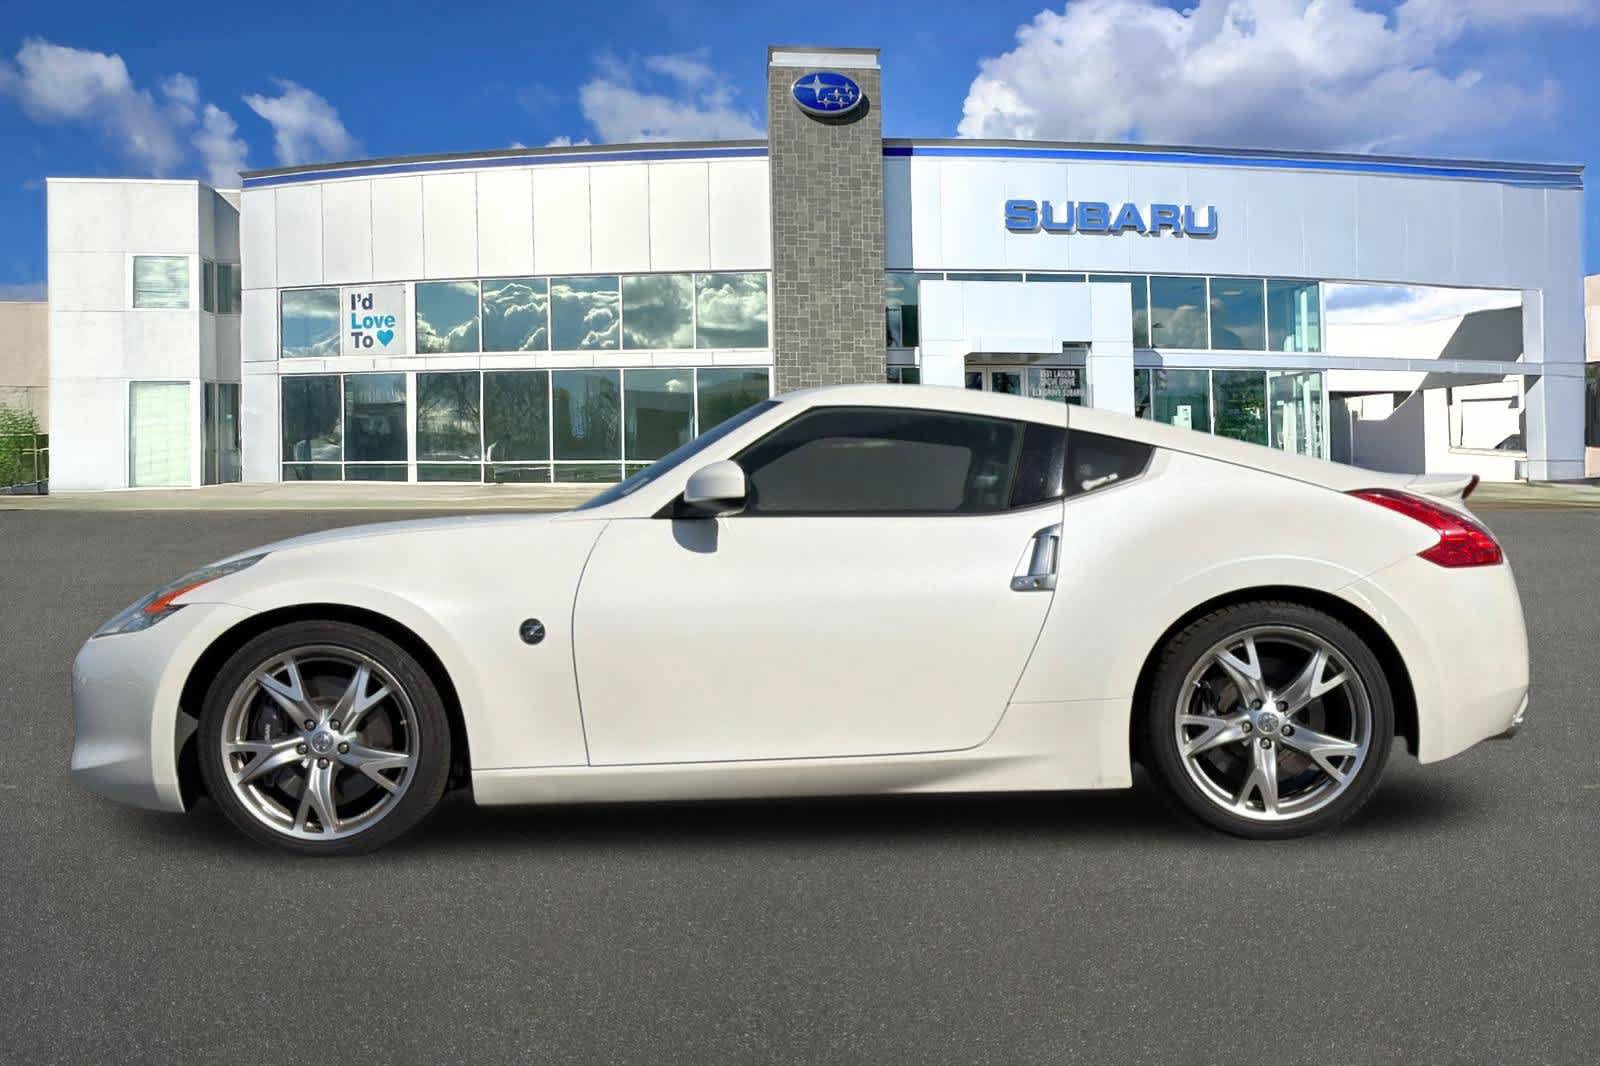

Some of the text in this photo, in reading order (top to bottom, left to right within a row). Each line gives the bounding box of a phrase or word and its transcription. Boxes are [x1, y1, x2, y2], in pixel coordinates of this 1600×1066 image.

[1005, 199, 1218, 238] SUBARU
[351, 293, 373, 310] I'd
[351, 313, 396, 329] Love
[351, 332, 374, 348] To
